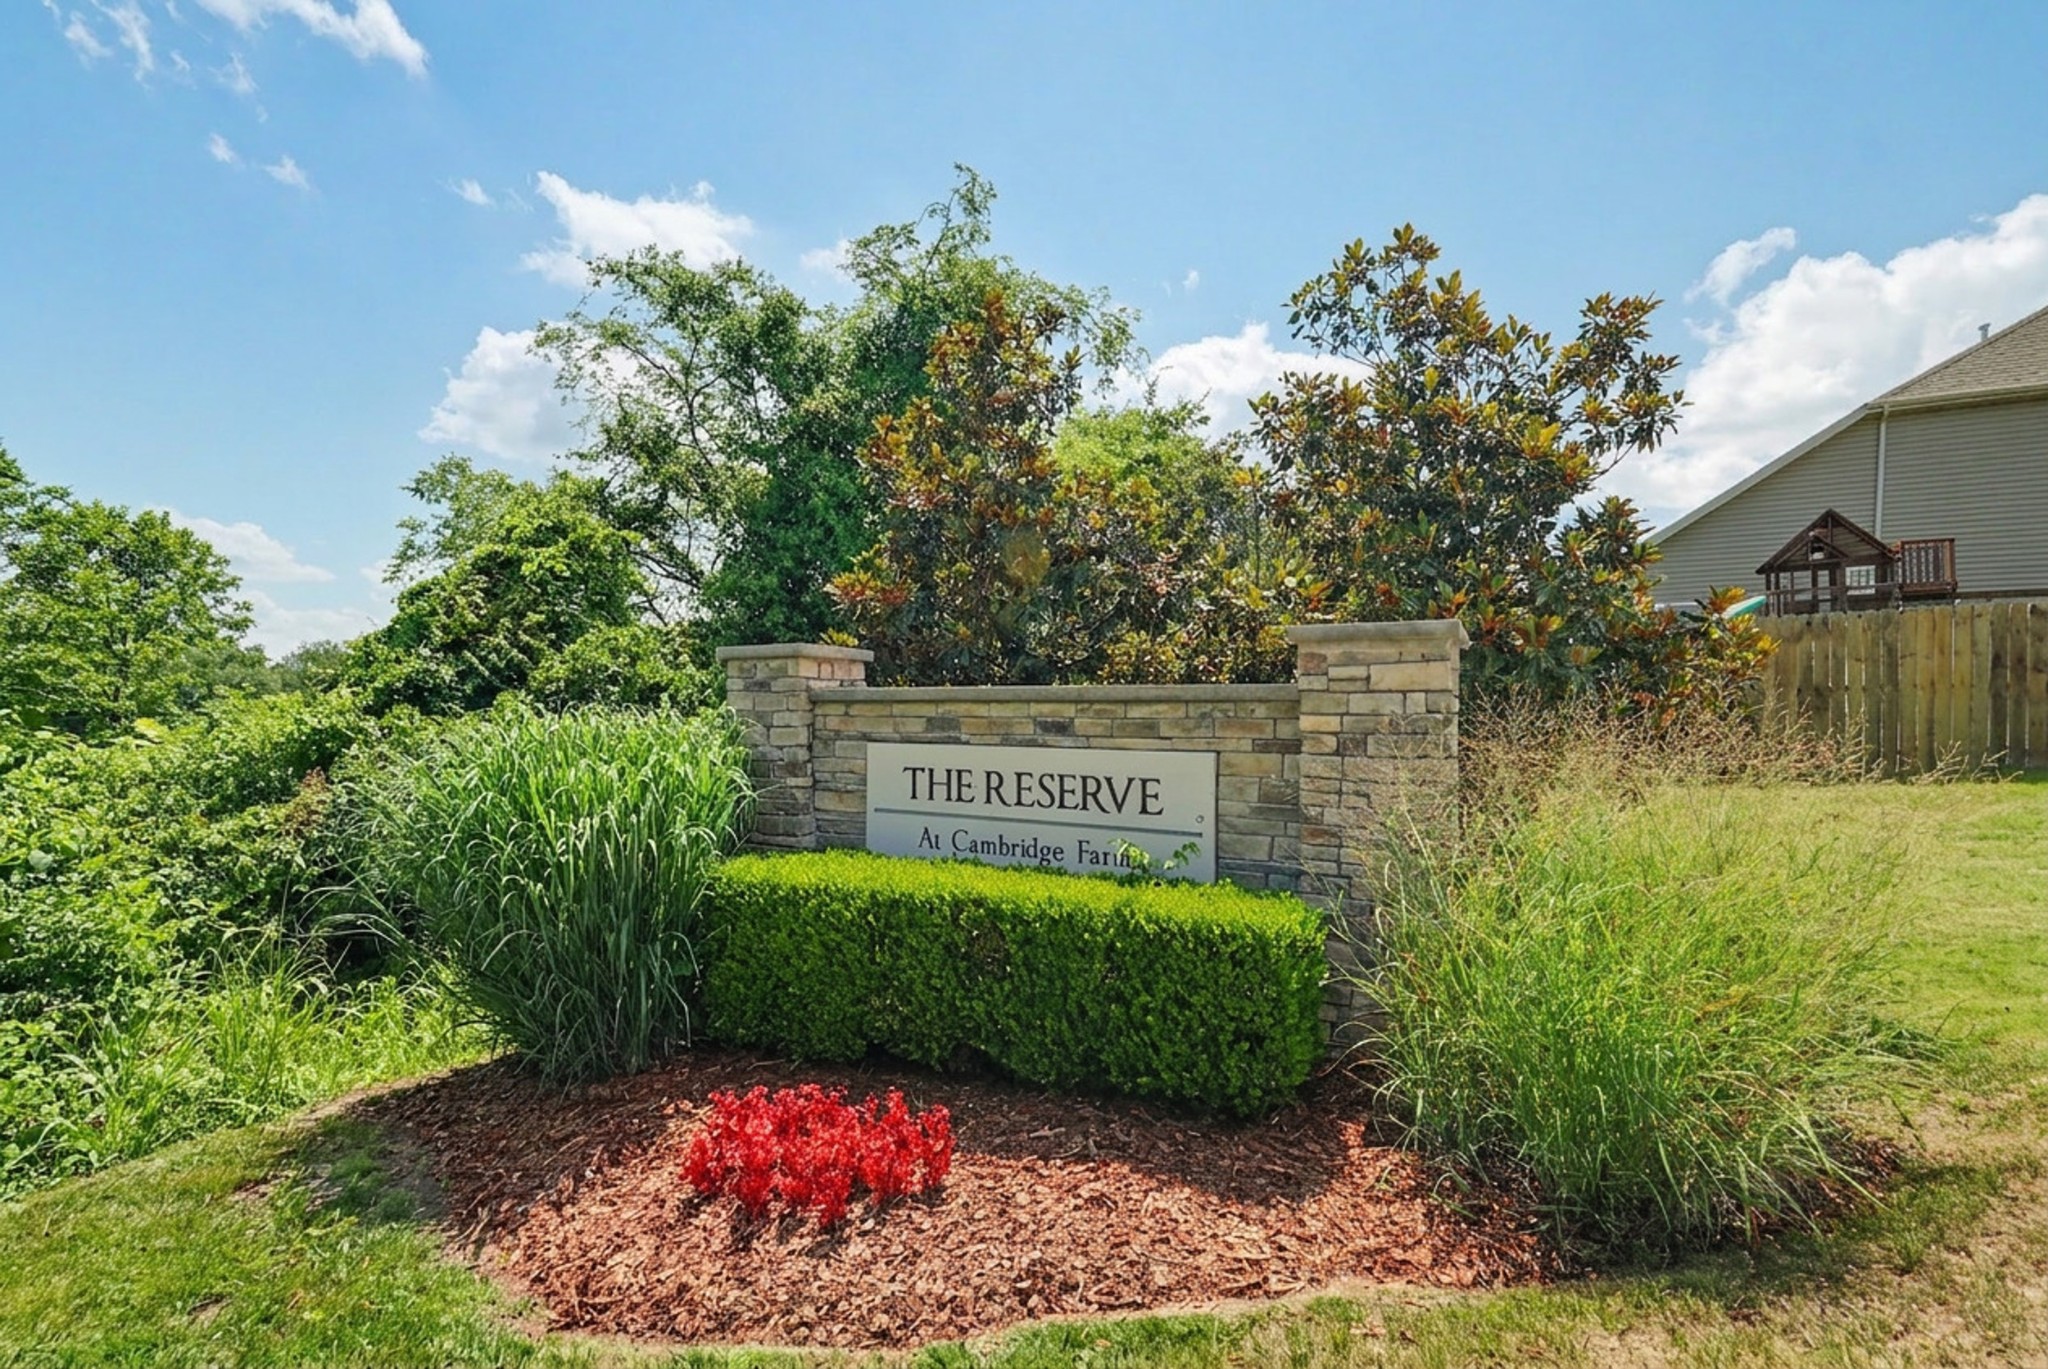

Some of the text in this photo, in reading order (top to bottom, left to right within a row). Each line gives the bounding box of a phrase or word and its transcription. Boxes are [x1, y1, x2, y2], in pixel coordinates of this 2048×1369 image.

[903, 766, 1164, 816] THE RESERVE
[918, 826, 941, 850] At
[951, 829, 1065, 866] Cambridge
